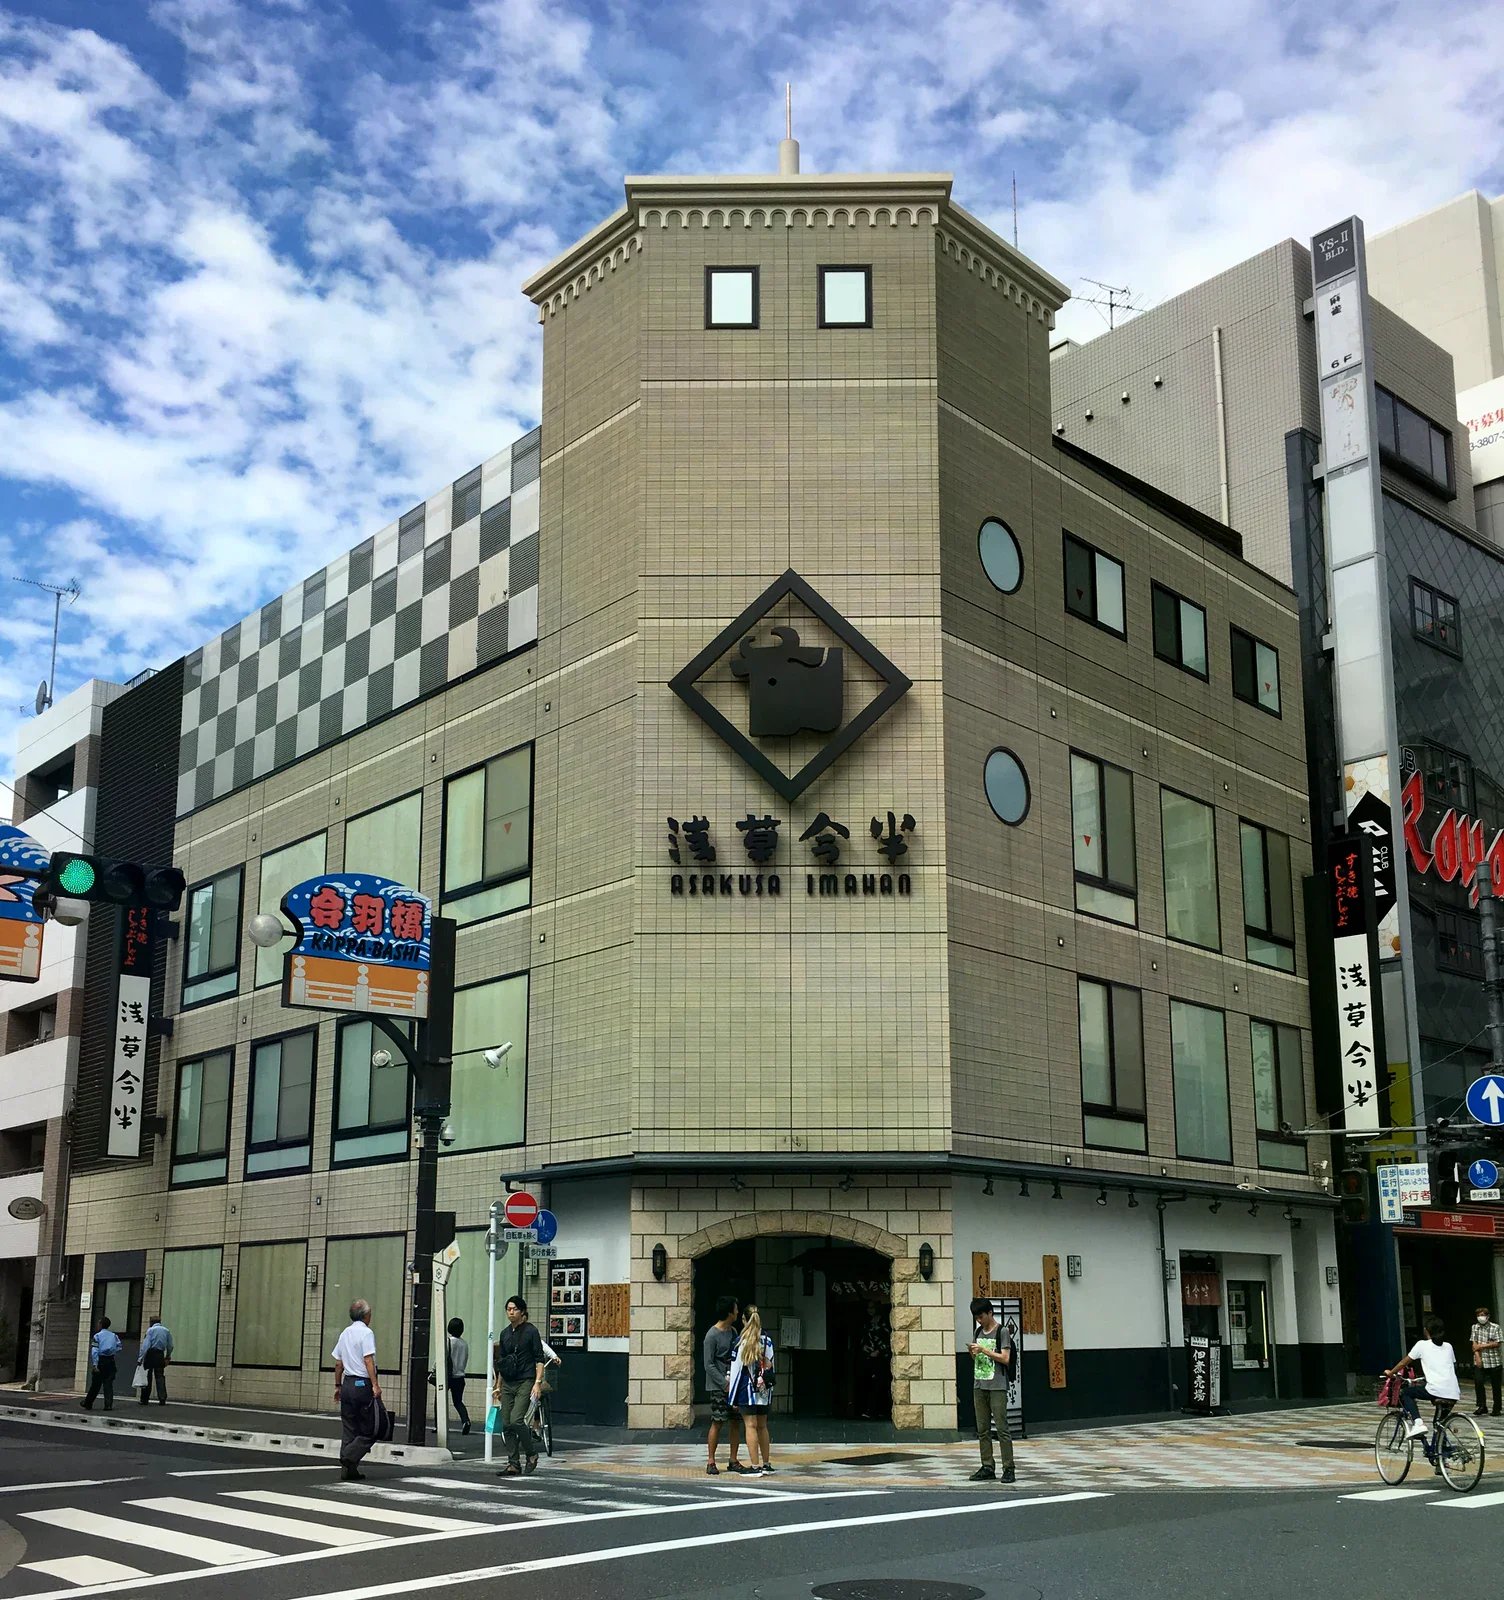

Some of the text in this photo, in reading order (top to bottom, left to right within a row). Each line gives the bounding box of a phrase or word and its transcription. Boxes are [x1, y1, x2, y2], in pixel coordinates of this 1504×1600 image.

[1325, 247, 1348, 261] BLD.
[1331, 353, 1352, 369] 6F
[667, 811, 916, 864] 浅草今半
[1380, 846, 1389, 869] CLUB
[671, 874, 911, 895] ASAKUSA IMAHAN
[1335, 864, 1349, 927] しゃぶしゃぶ
[1346, 853, 1358, 898] すき焼
[309, 886, 424, 942] 合羽橋
[1340, 963, 1372, 1107] 浅草今半
[115, 1001, 145, 1130] 浅草今半
[505, 1231, 536, 1240] 自転車を除く
[530, 1248, 557, 1257] 歩行者優先
[1193, 1350, 1206, 1402] 佃煮売場
